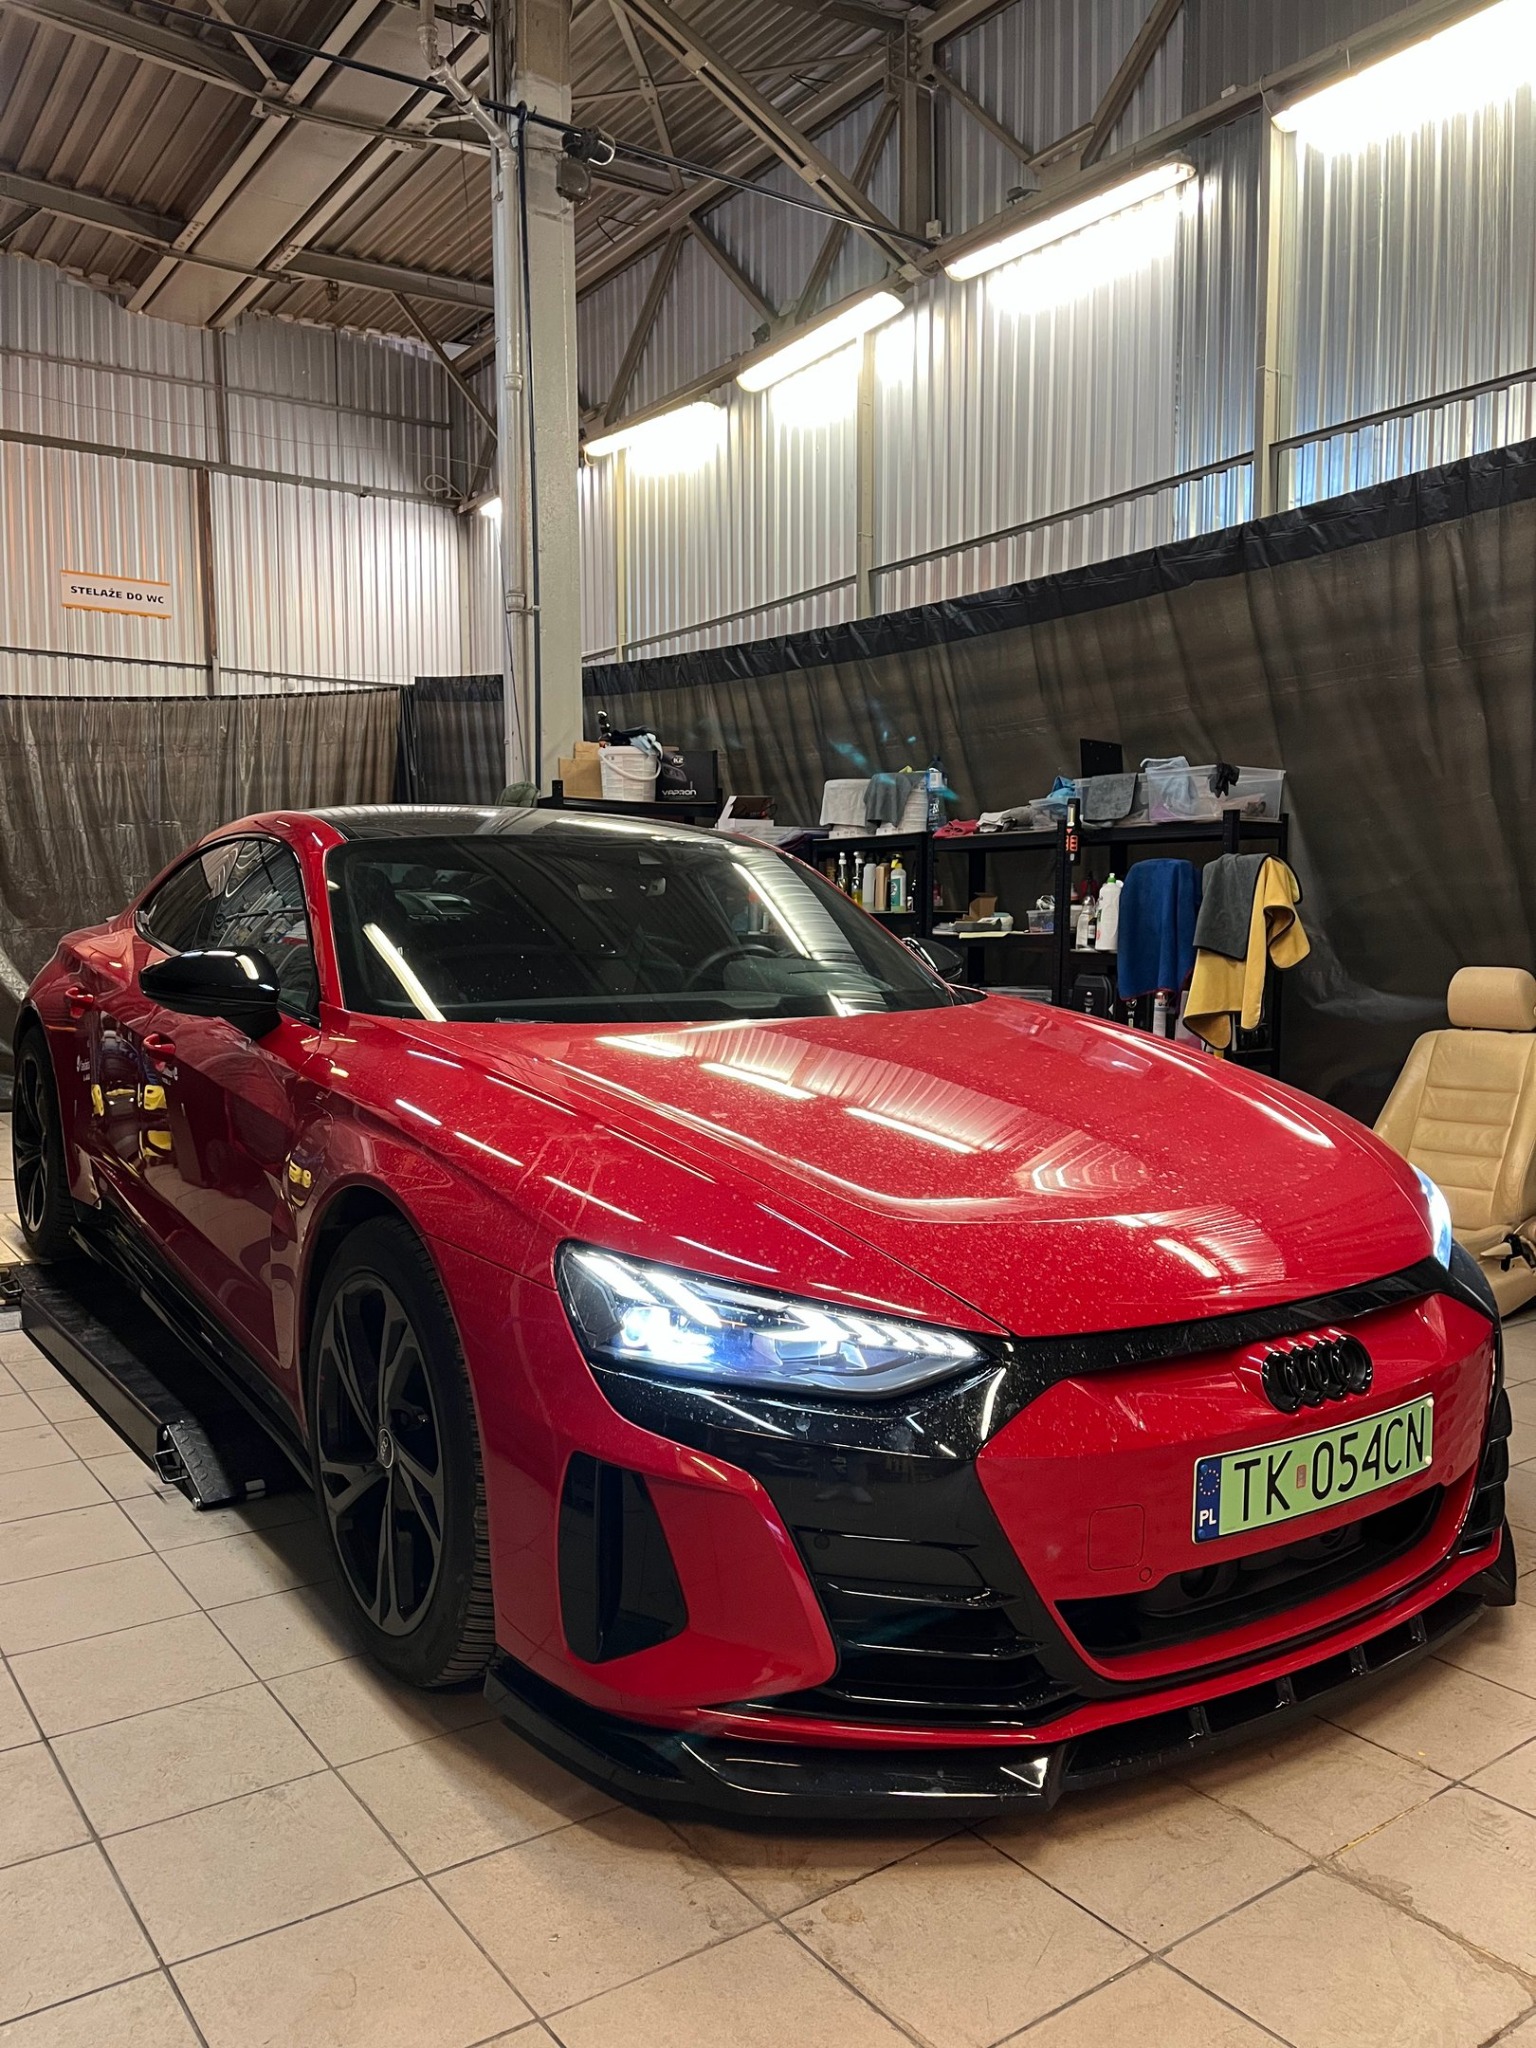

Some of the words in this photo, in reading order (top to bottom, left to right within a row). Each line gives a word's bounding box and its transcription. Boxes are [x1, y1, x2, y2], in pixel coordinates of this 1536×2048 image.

[70, 585, 123, 599] STELAŻE
[126, 592, 143, 601] DO
[146, 594, 165, 604] WC
[1234, 1450, 1293, 1522] TK
[1312, 1405, 1425, 1501] 054CN
[1199, 1508, 1217, 1527] PL
